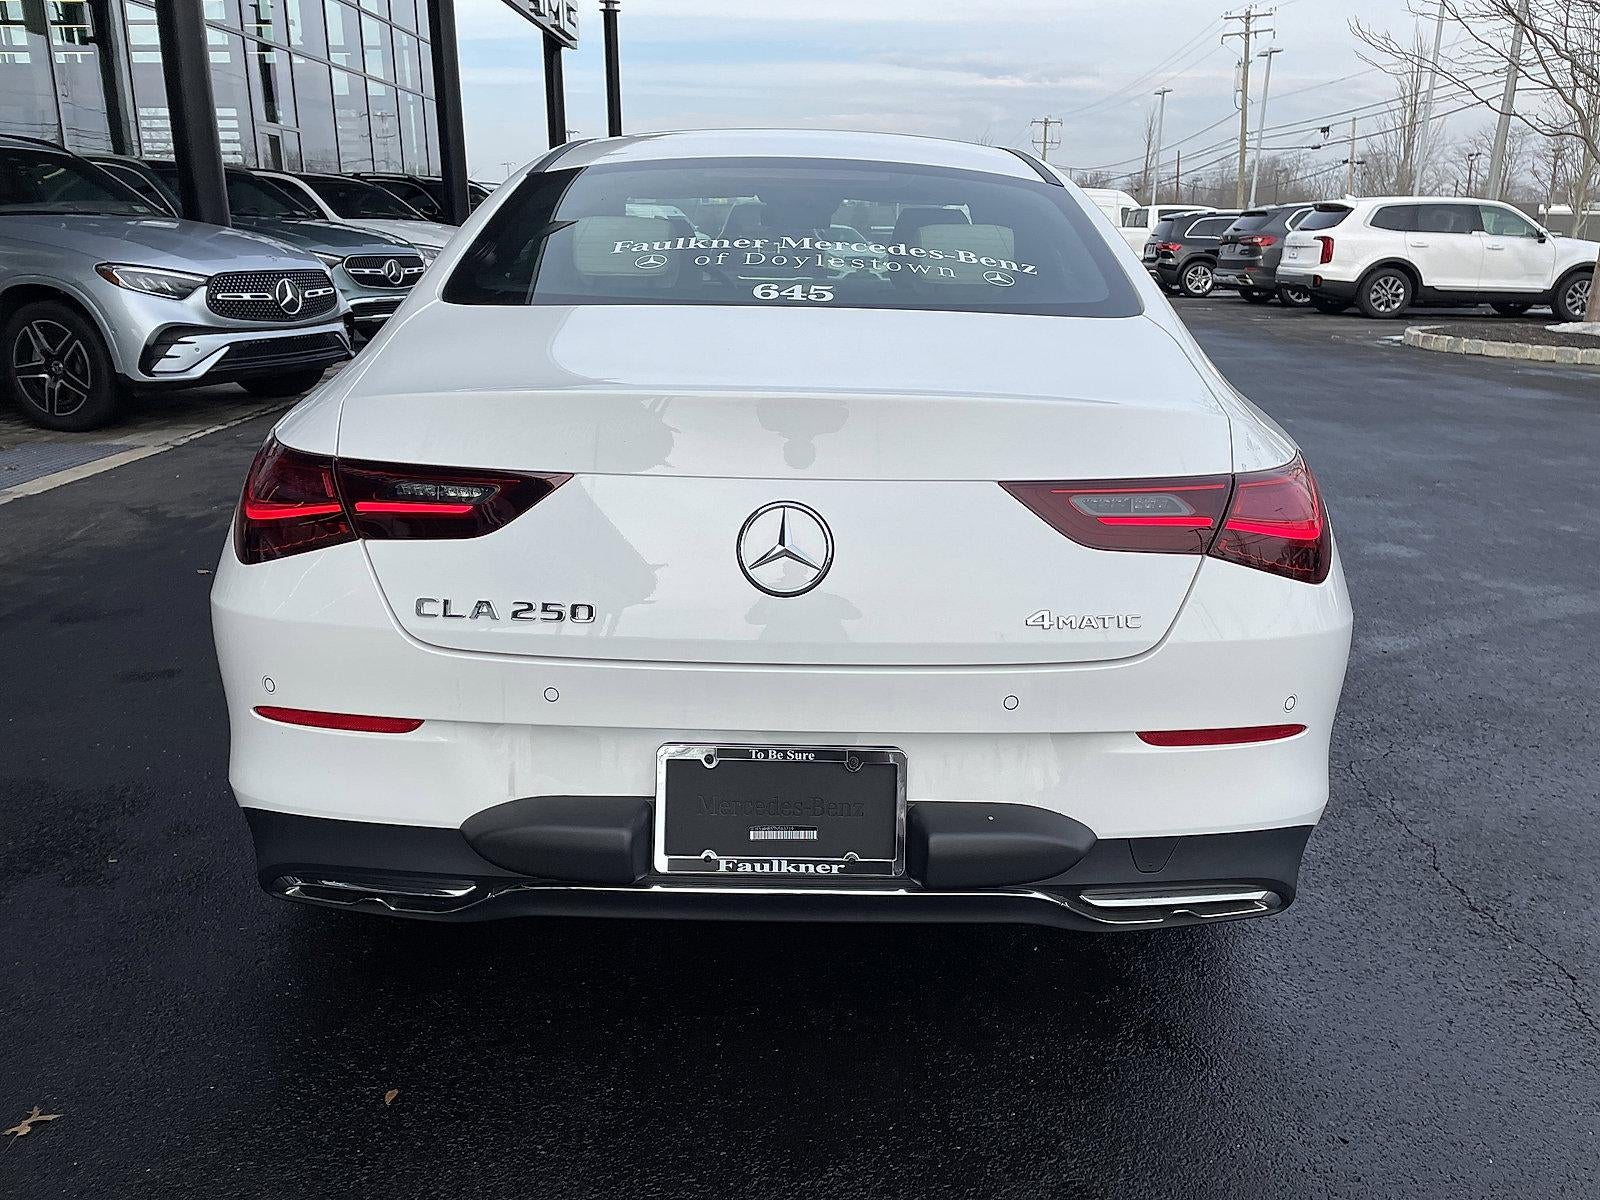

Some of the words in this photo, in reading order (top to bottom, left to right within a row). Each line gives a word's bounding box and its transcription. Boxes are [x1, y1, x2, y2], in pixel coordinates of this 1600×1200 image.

[610, 236, 769, 255] Faulkner
[779, 236, 1039, 276] Mercedes-Benz
[693, 252, 730, 266] of
[742, 252, 956, 278] Doylestown
[752, 283, 835, 302] 645
[415, 597, 500, 620] CLA
[510, 601, 597, 623] 250
[1025, 609, 1142, 630] 4MATIC
[748, 749, 765, 760] To
[768, 749, 784, 760] Be
[786, 750, 816, 761] Sure
[697, 795, 865, 818] Mercedes-Benz
[717, 859, 846, 875] Faulkner
